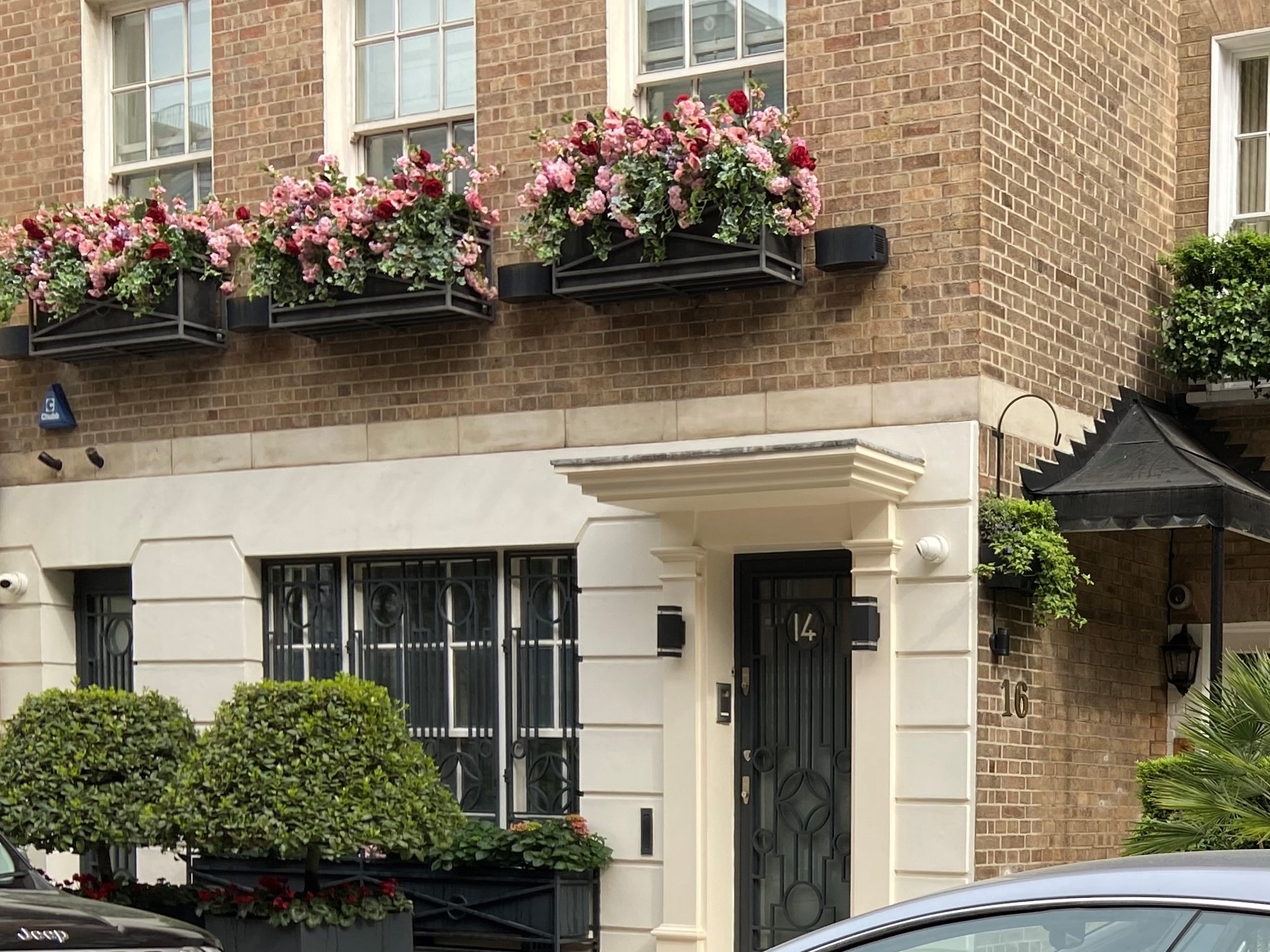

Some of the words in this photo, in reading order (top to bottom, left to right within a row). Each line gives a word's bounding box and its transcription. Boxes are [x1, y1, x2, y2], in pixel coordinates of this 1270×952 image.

[794, 612, 817, 642] 14
[1000, 678, 1029, 720] 16
[17, 927, 70, 944] Jeep
